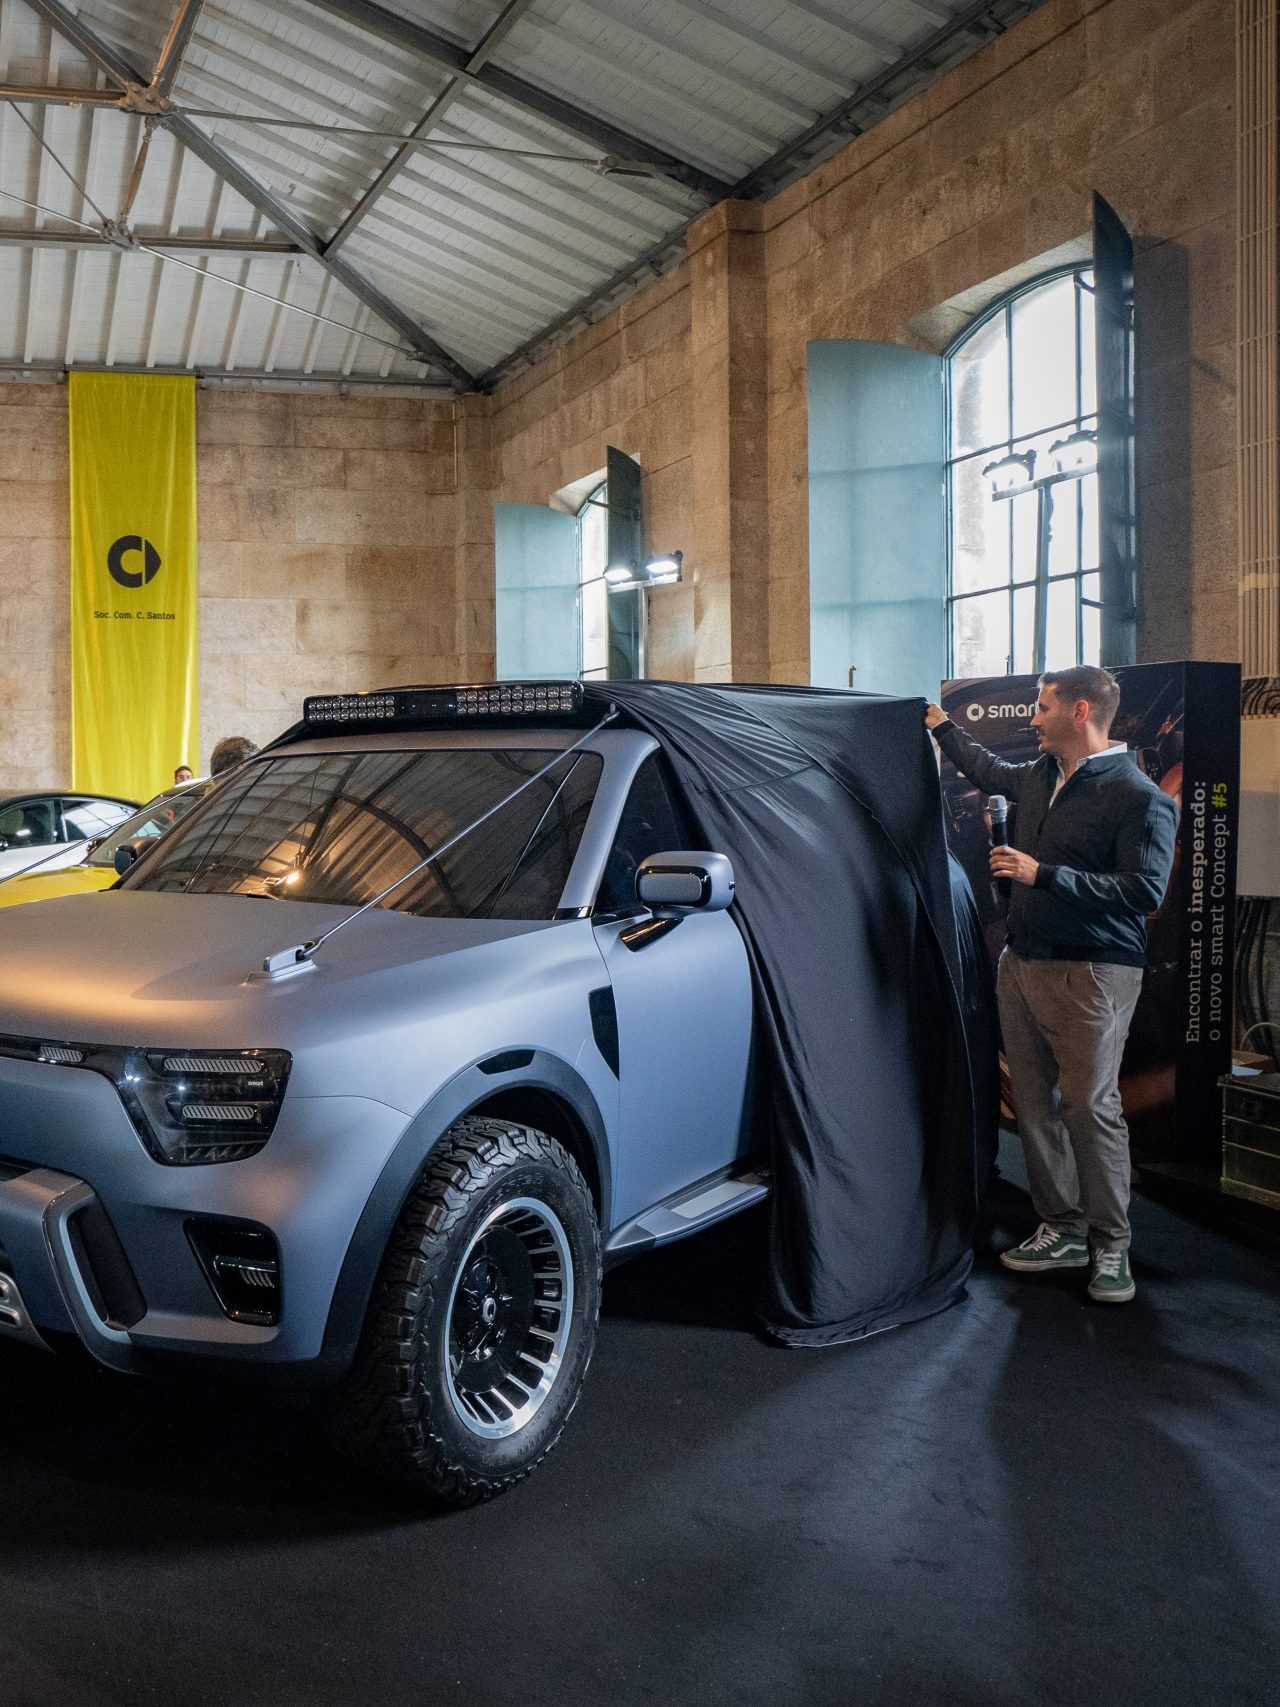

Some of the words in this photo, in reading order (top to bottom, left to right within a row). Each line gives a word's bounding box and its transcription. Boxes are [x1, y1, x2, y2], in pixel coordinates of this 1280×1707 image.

[94, 611, 111, 619] Soc.
[114, 611, 135, 619] Com.
[136, 611, 145, 619] C.
[147, 612, 176, 620] Santos
[1211, 783, 1227, 808] #5
[1187, 781, 1208, 913] inesperado:
[1211, 814, 1230, 898] Concept
[1191, 920, 1202, 932] o
[1210, 905, 1225, 966] smart
[1186, 938, 1202, 1044] Encontrar
[1209, 973, 1223, 1022] novo
[1209, 1029, 1221, 1041] o
